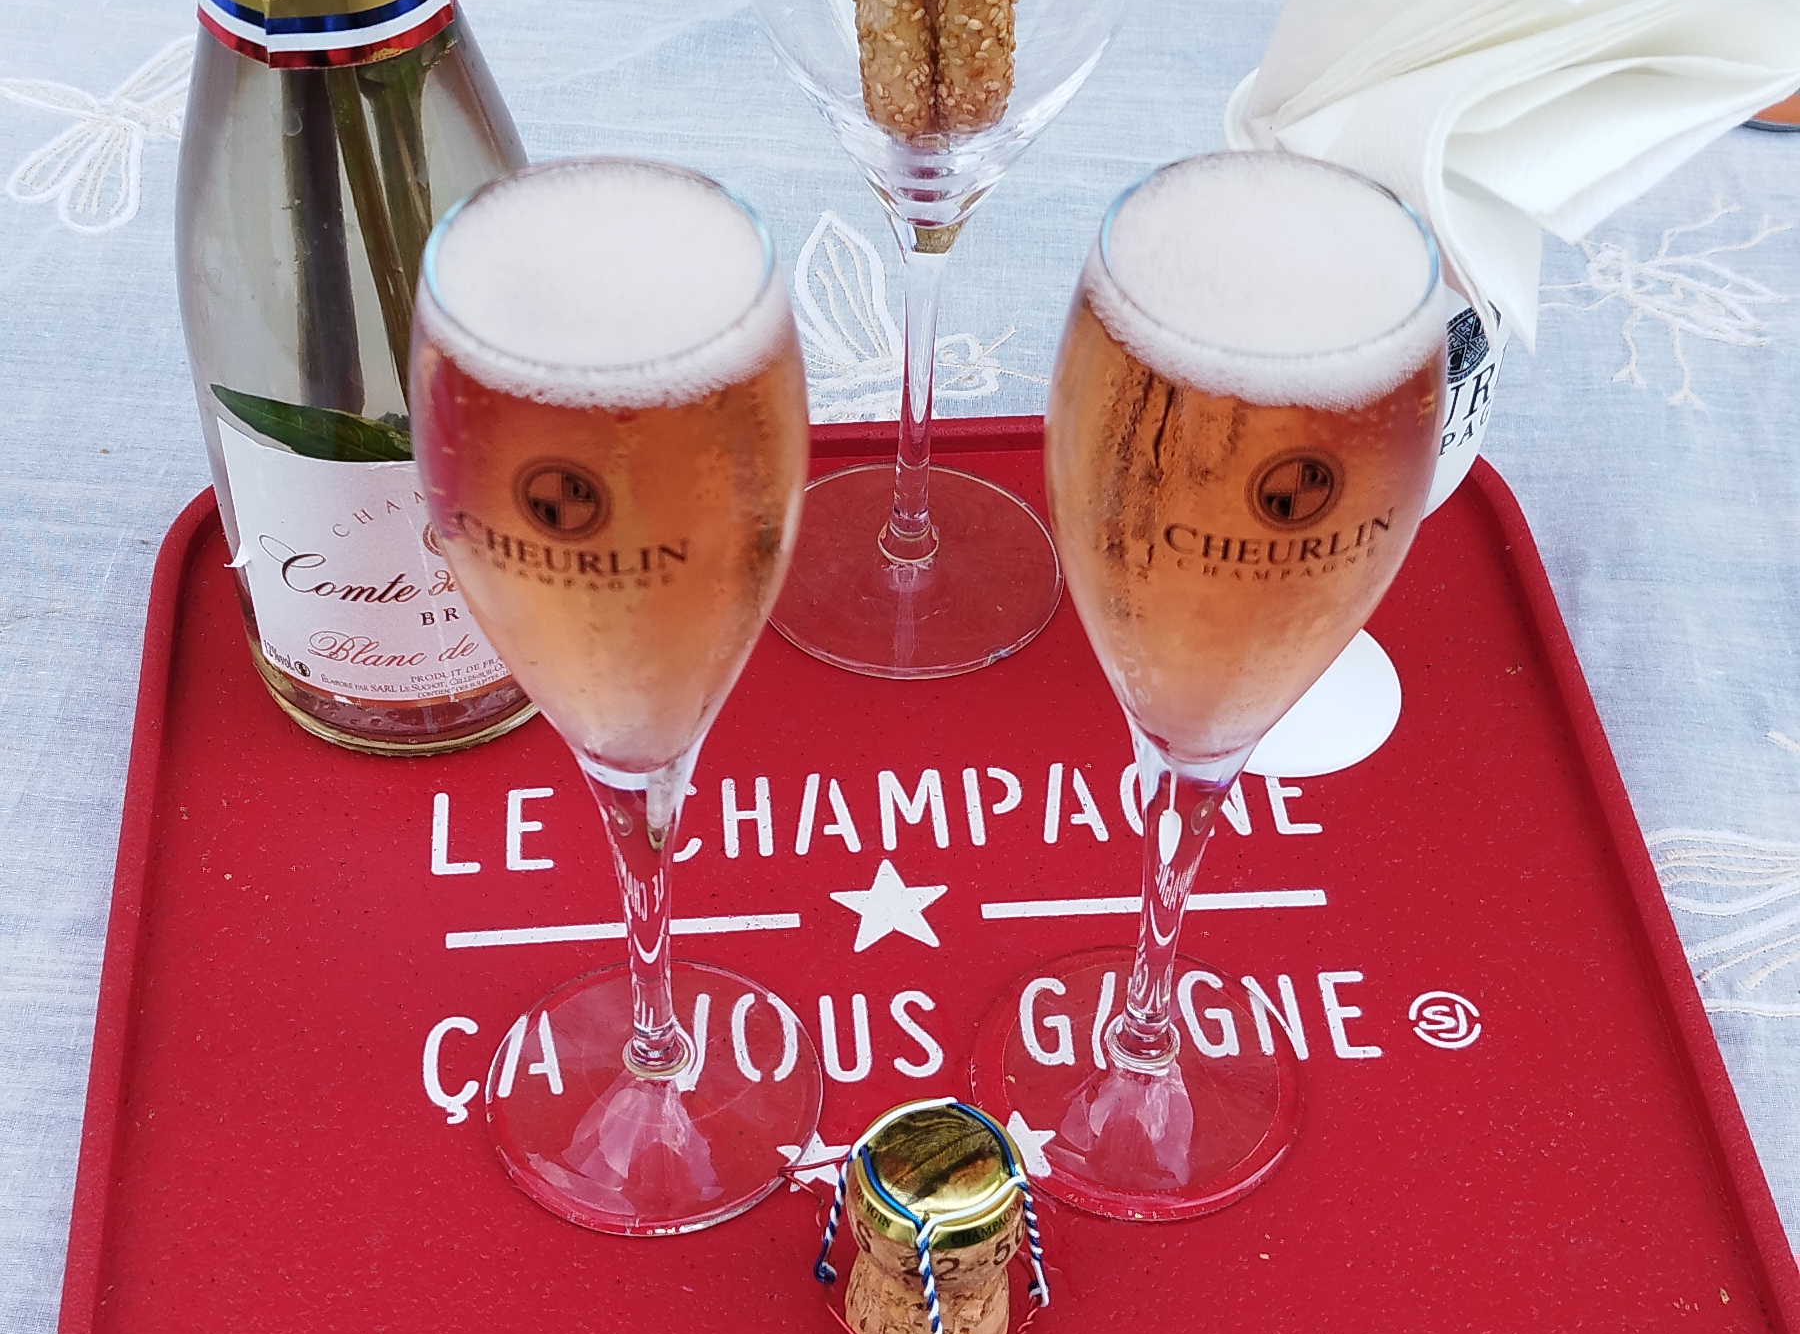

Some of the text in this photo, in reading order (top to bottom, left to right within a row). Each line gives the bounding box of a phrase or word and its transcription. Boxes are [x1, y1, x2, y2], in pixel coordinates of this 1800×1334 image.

[259, 534, 421, 603] Comte
[456, 509, 690, 576] CHEURLIN
[1163, 506, 1395, 566] CHEURLIN
[308, 630, 480, 667] Blanc de
[431, 788, 554, 875] LE
[422, 1010, 564, 1124] ÇA
